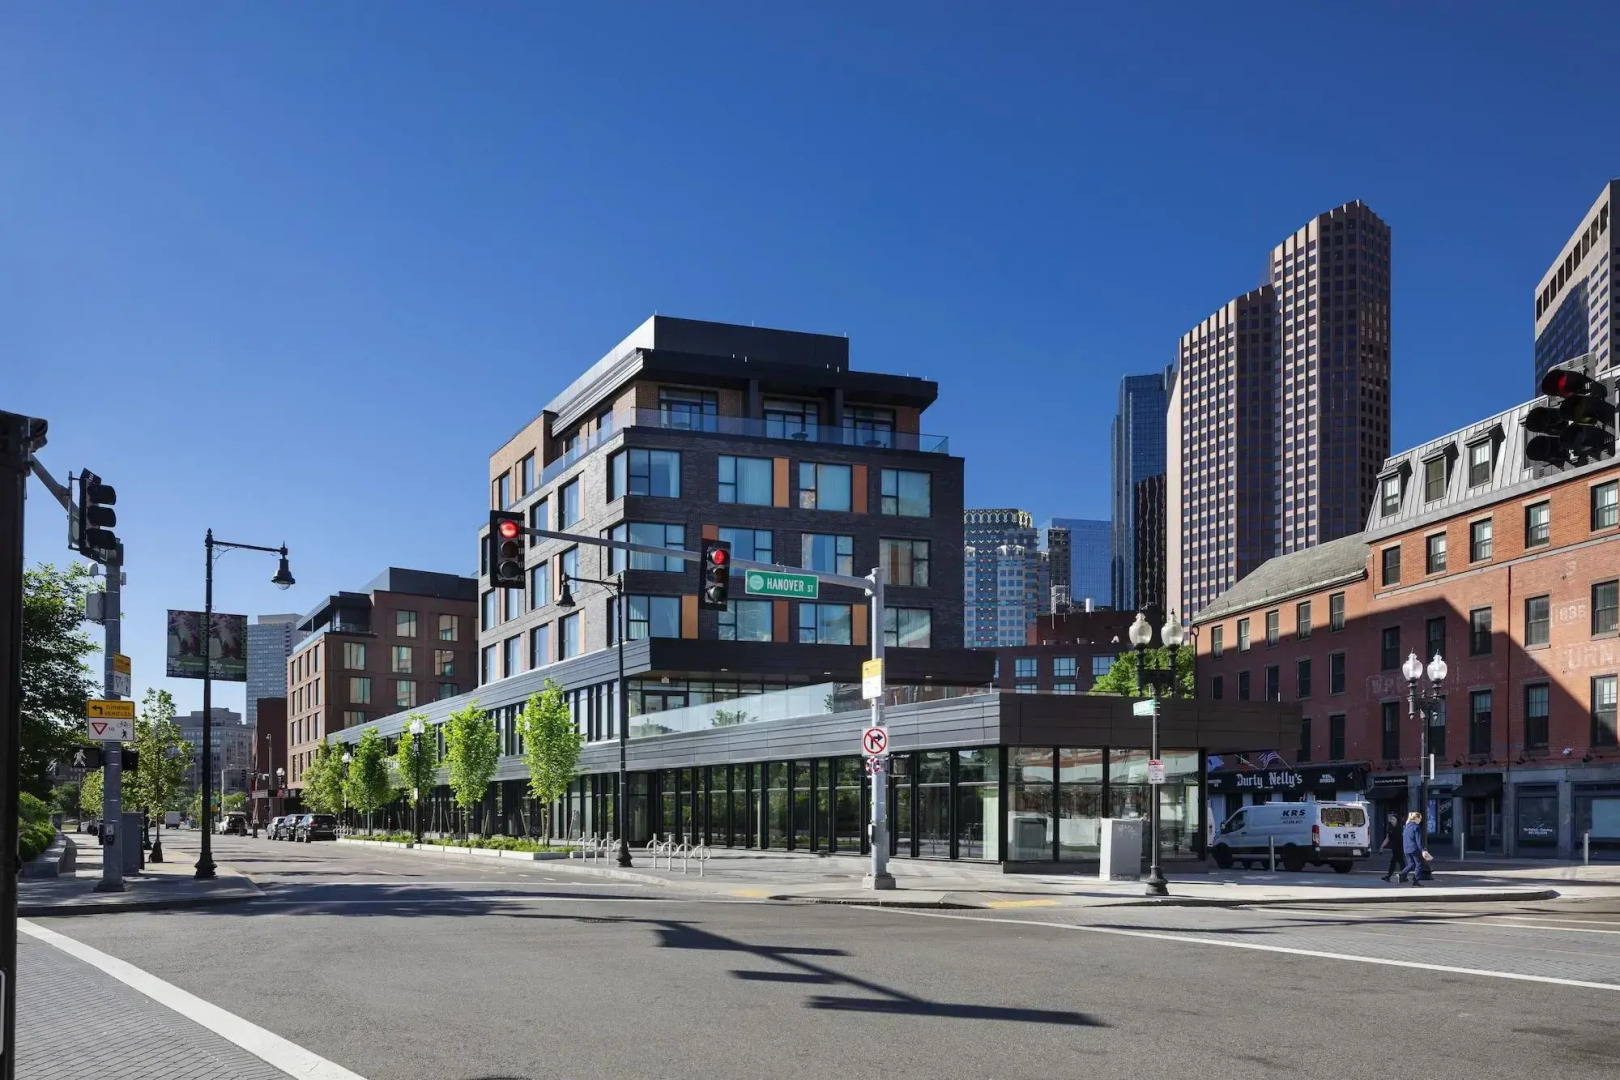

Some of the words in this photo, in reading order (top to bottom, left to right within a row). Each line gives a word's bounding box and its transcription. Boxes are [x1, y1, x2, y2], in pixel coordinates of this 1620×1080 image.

[767, 577, 804, 592] HANOVER
[807, 585, 814, 593] ST
[1236, 773, 1263, 789] Durty
[1269, 770, 1303, 788] Nelly's
[1282, 809, 1306, 817] KRS
[1334, 832, 1357, 840] KRS
